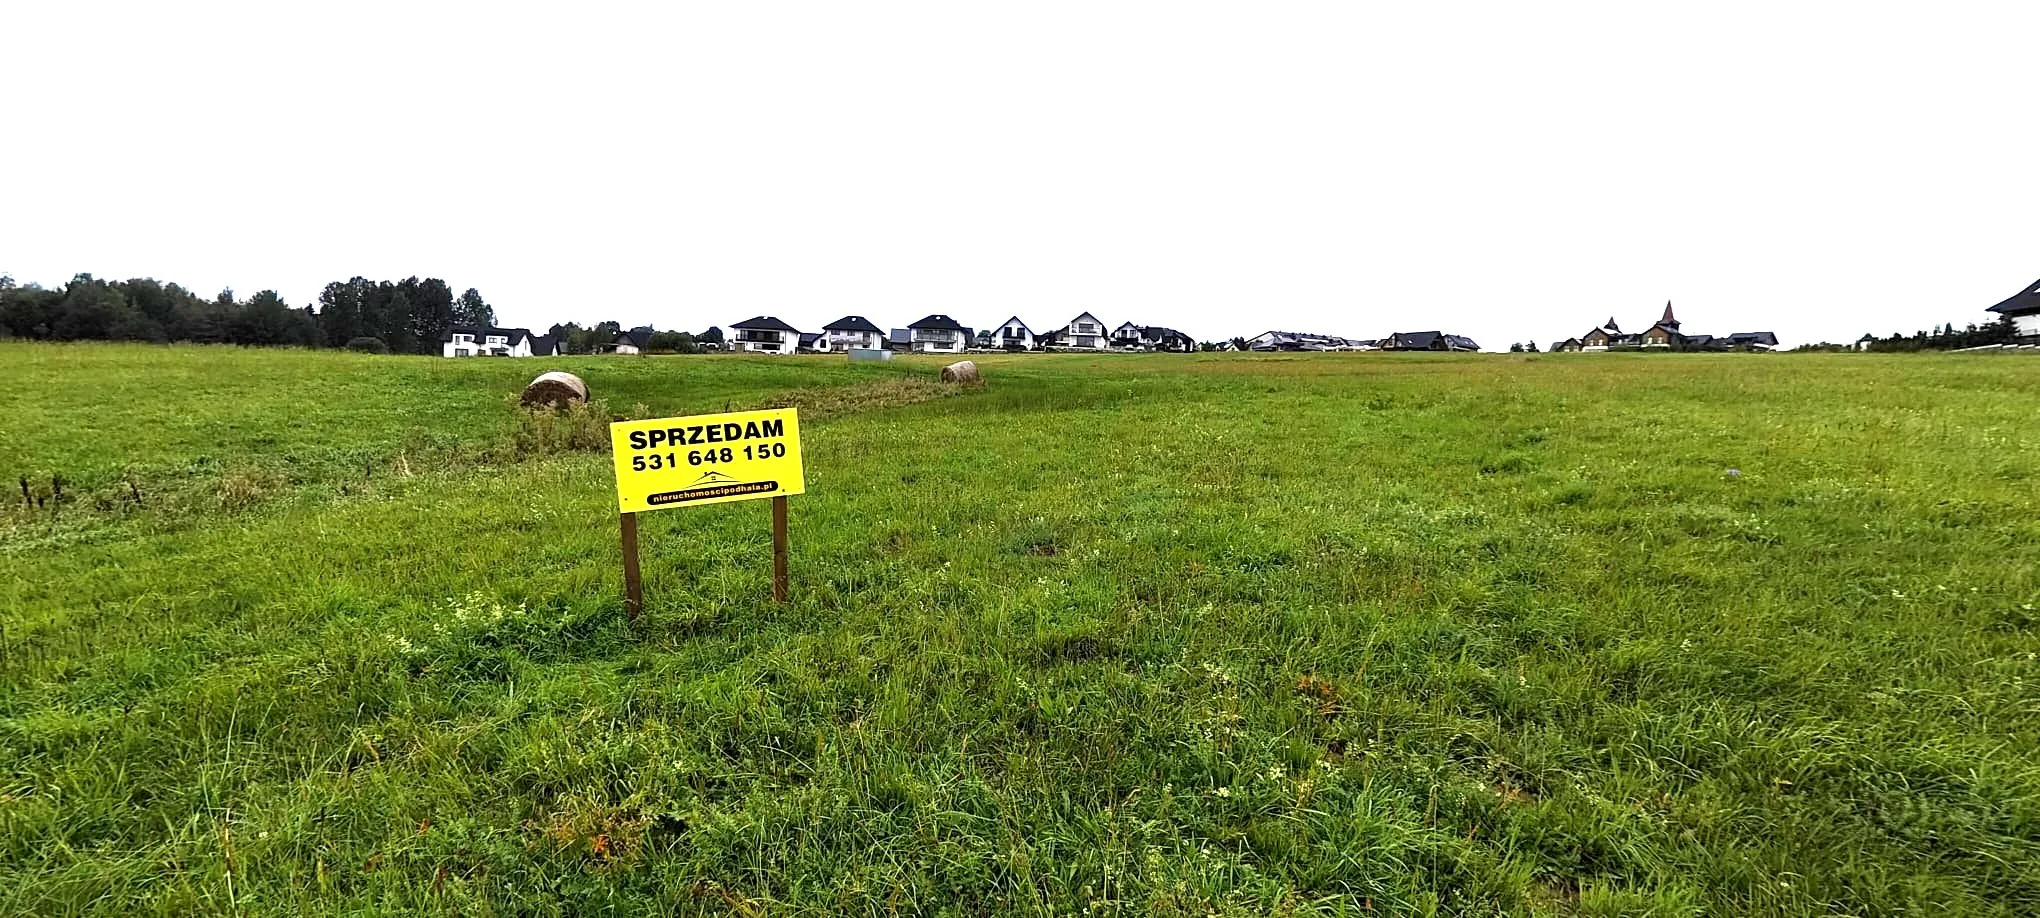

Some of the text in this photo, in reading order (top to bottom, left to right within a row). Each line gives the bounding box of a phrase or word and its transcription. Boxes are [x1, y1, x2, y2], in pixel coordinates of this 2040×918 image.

[629, 419, 784, 450] SPRZEDAM
[632, 442, 786, 471] 531 648 150
[653, 482, 773, 503] nieruchomoscipodhala.pl
